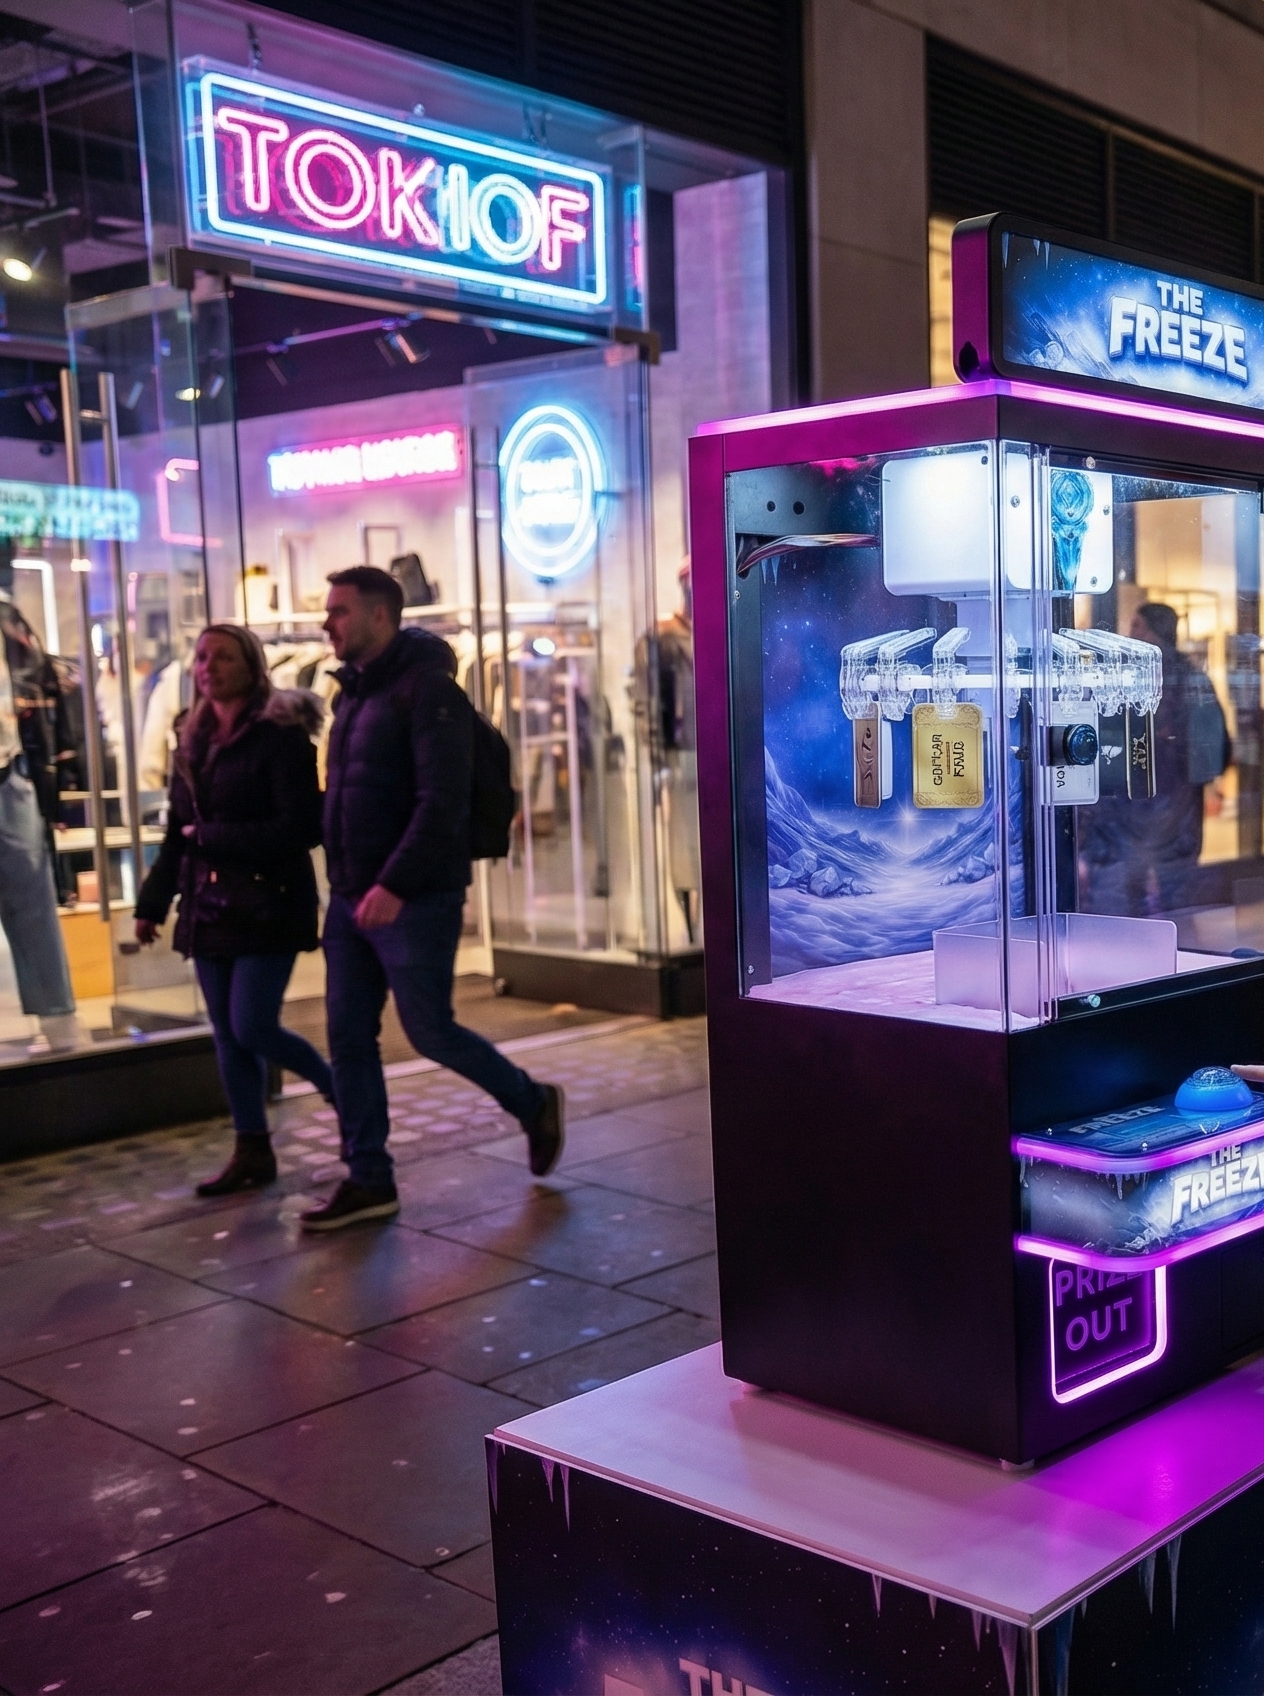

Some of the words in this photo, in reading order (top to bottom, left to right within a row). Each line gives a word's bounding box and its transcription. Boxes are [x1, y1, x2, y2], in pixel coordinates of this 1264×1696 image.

[217, 107, 590, 271] TOKIOF
[1156, 280, 1204, 316] THE
[1109, 296, 1248, 384] FREEZE
[1065, 1297, 1133, 1351] OUT
[679, 1657, 775, 1696] TH
